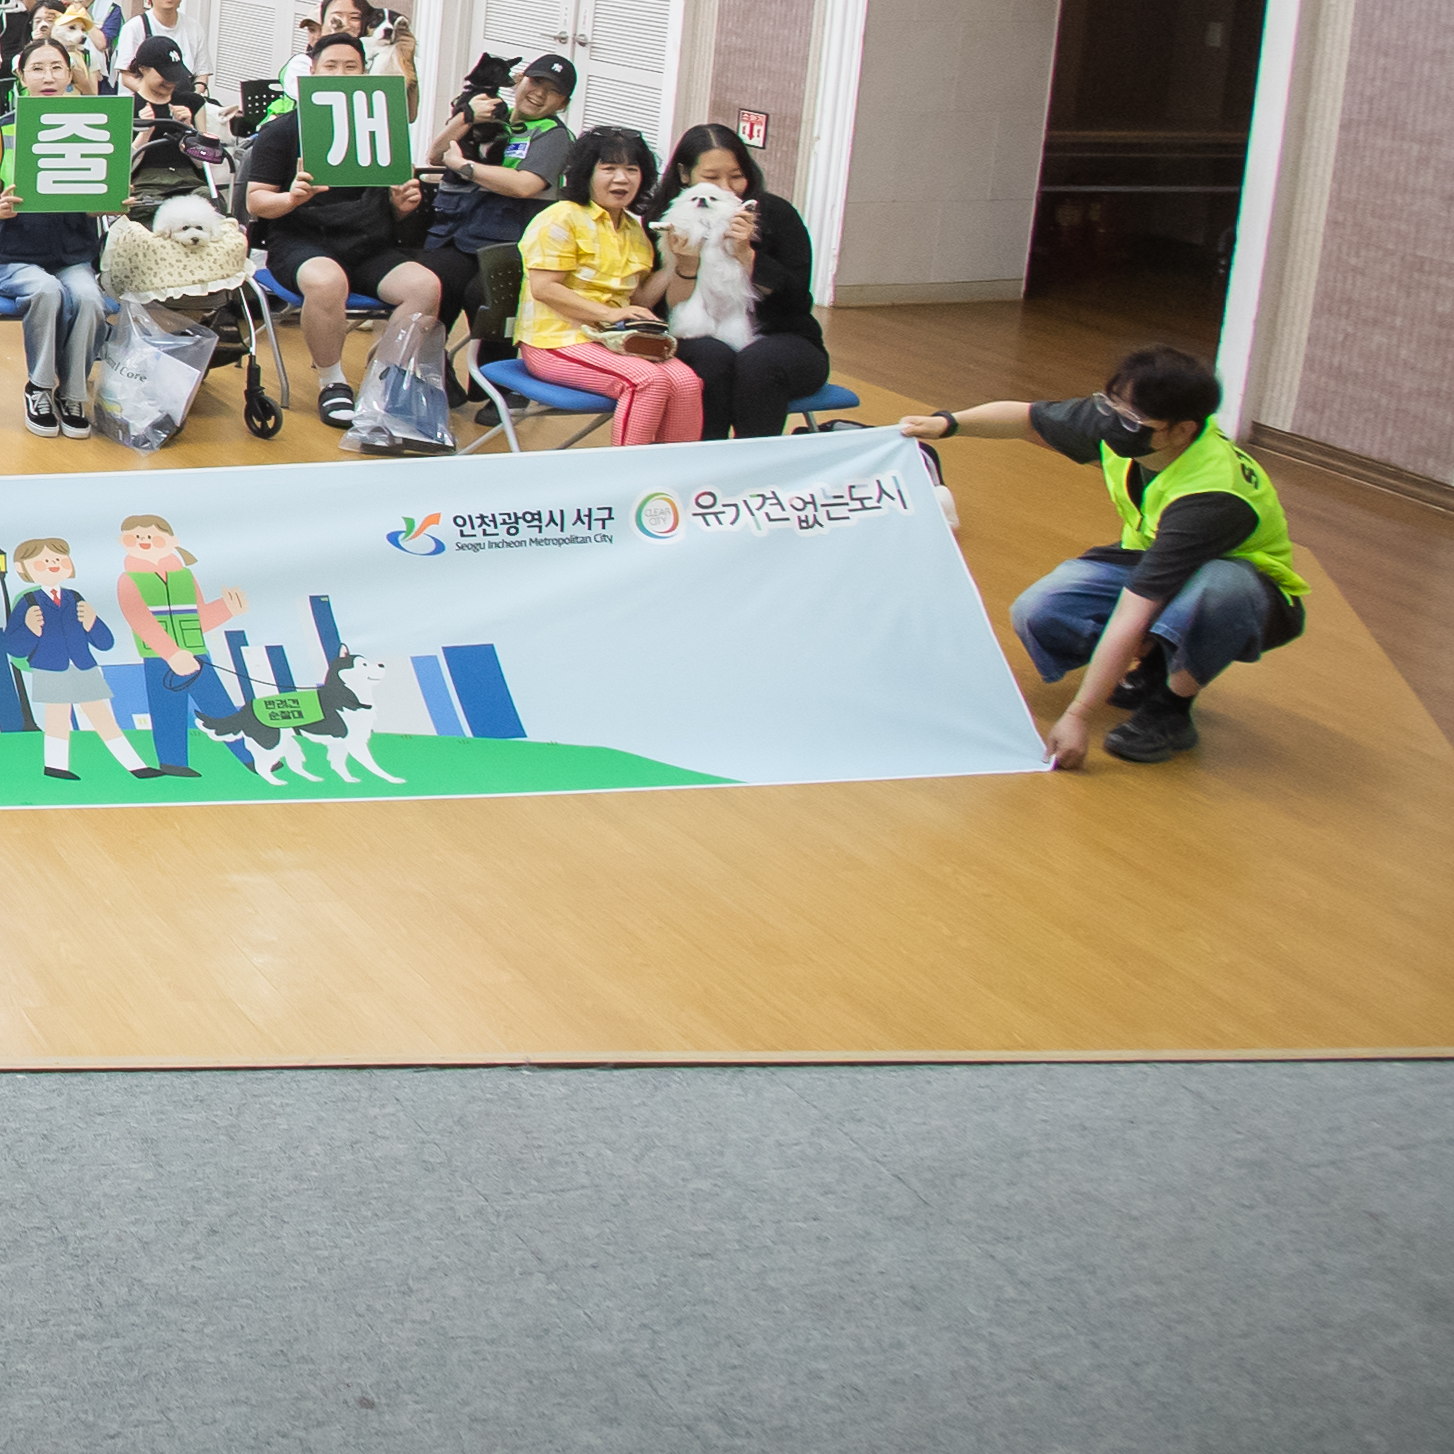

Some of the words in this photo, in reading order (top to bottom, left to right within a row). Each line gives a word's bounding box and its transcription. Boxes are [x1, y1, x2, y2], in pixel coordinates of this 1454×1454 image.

[31, 113, 115, 195] 줄
[311, 90, 391, 167] 개
[452, 509, 565, 538] 인천광역시
[572, 506, 615, 531] 서구
[455, 541, 486, 553] Seogu
[488, 538, 527, 550] Incheon
[528, 533, 592, 548] Metropolitan
[593, 532, 614, 544] City
